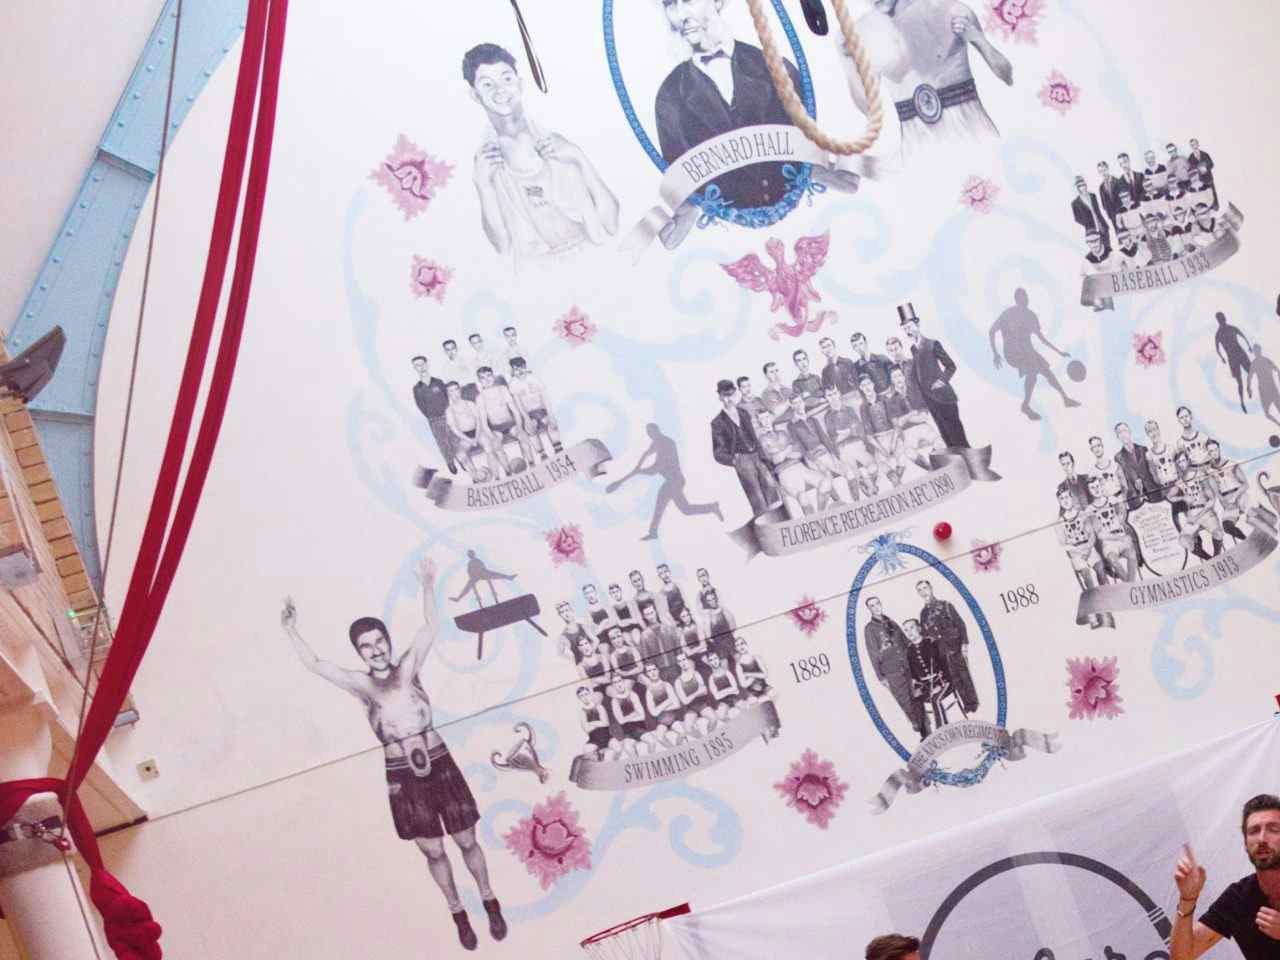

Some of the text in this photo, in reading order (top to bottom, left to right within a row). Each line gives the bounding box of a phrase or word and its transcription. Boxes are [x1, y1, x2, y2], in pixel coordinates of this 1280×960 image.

[682, 131, 794, 183] BERNARD HALL
[1112, 264, 1178, 293] BASEBALL
[467, 454, 577, 507] BASKETBALL 1954
[781, 515, 842, 547] FLORENCE
[840, 491, 911, 532] RECREATION
[909, 483, 932, 508] AFC
[999, 583, 1040, 614] 1988
[1130, 556, 1240, 606] GYMNASTICS 1913
[790, 653, 831, 684] 1889
[624, 732, 734, 784] SWIMMING 1895
